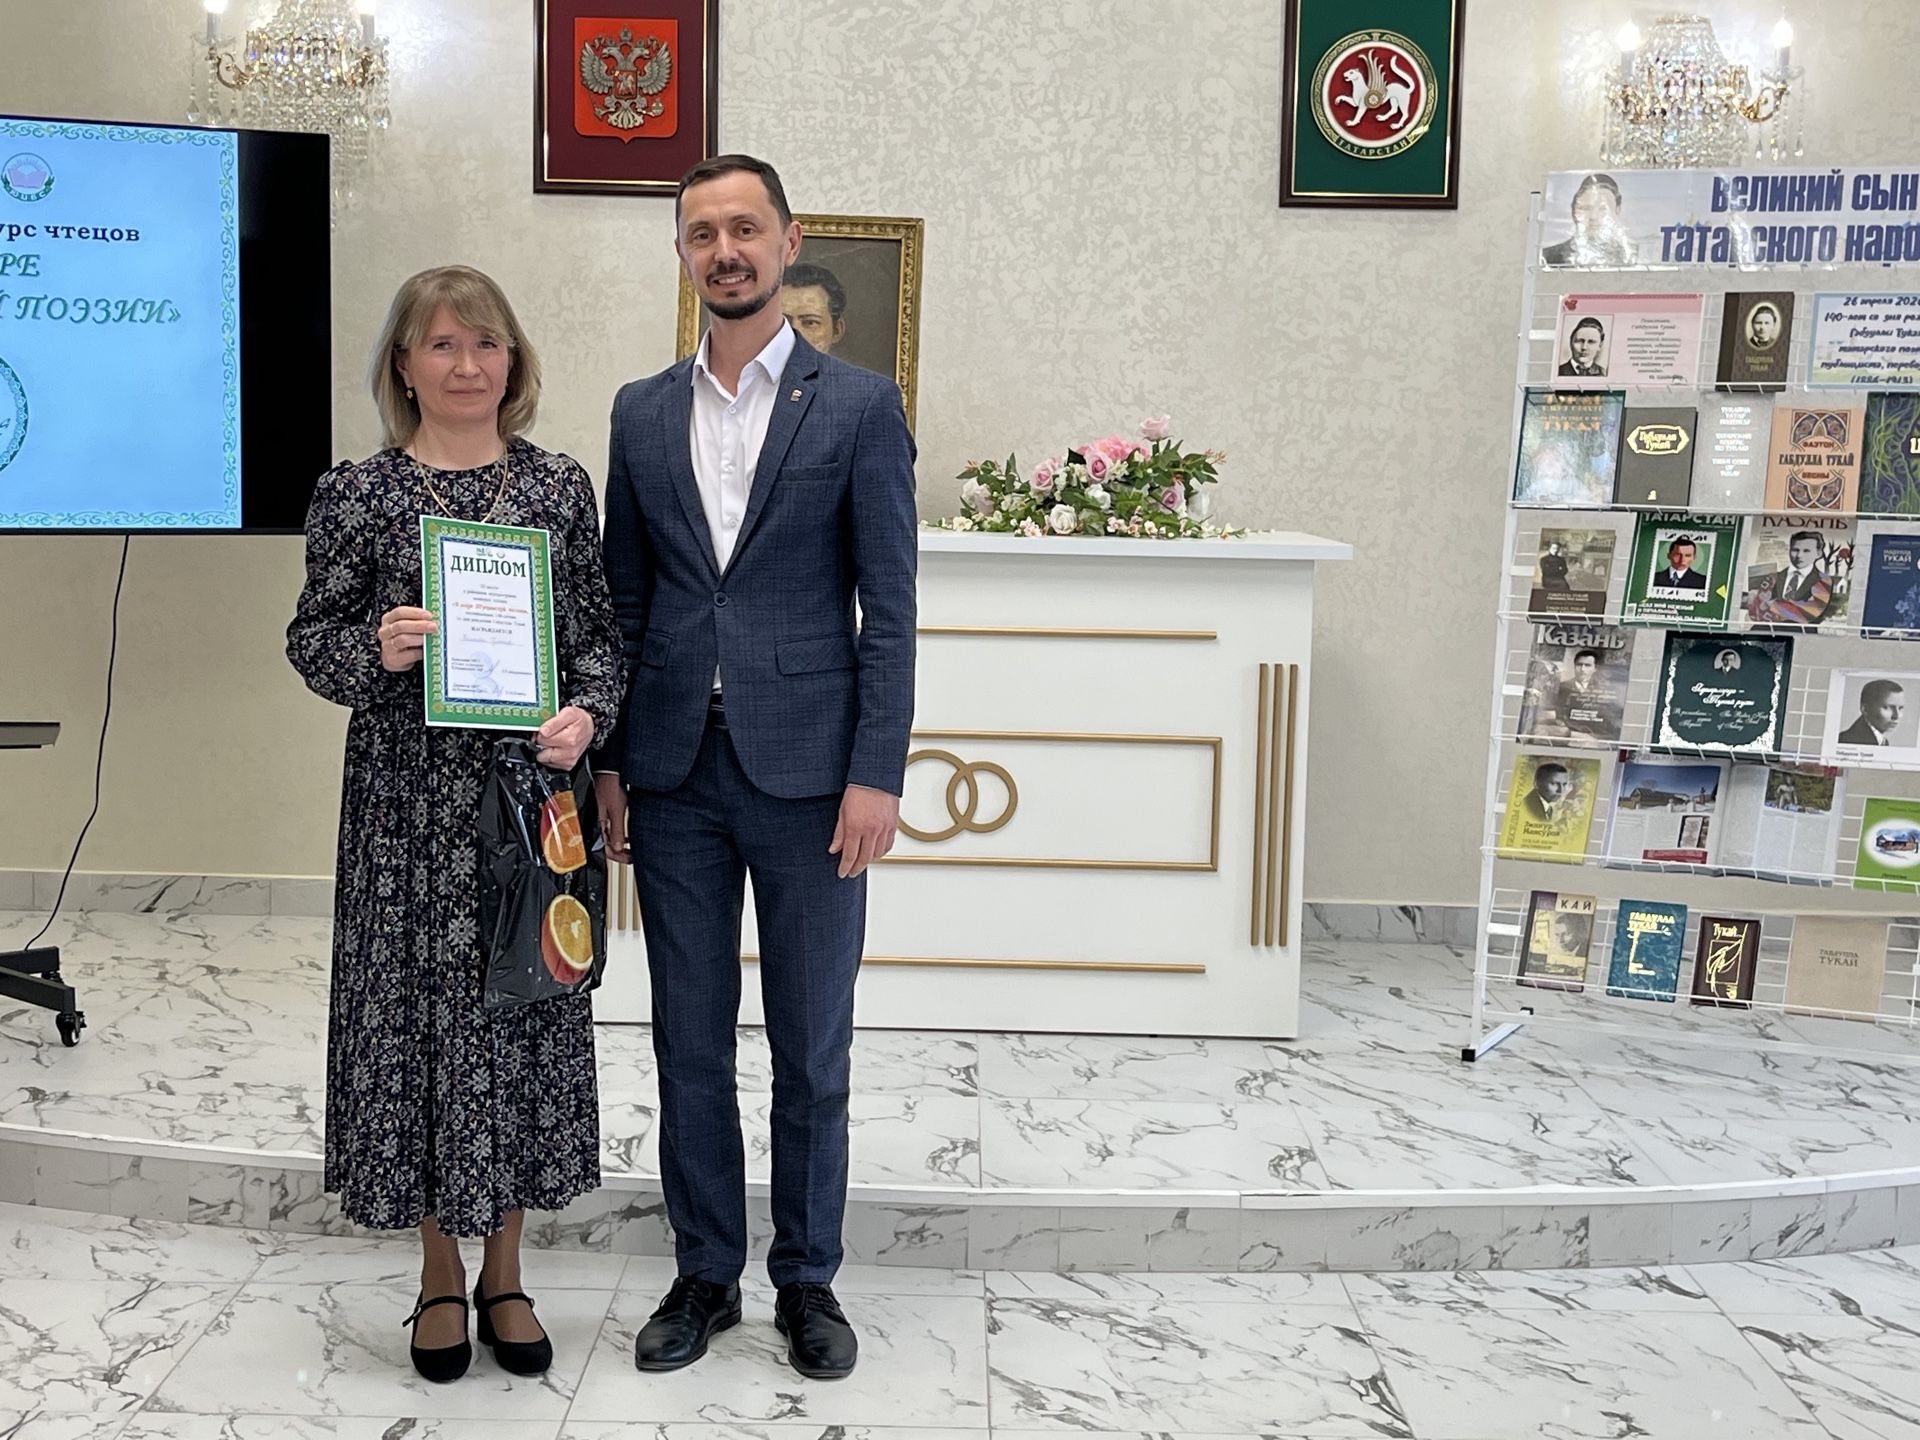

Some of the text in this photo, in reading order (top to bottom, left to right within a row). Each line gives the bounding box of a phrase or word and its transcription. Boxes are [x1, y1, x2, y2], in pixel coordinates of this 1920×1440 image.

[1338, 137, 1408, 156] ТАТАРСТАН
[44, 225, 140, 243] чтецов
[14, 294, 181, 324] ПОЭЗИИ»
[1843, 296, 1858, 306] 26
[1860, 298, 1893, 307] апреля
[1883, 314, 1901, 322] дня
[1849, 327, 1893, 338] Габдуллы
[1838, 345, 1896, 354] татарского
[1779, 452, 1854, 467] ГАБДУЛЛА ТУКАЙ
[451, 555, 526, 577] ДИПЛОМ
[1537, 624, 1625, 649] Казань
[1819, 955, 1858, 968] ТУКАЙ
